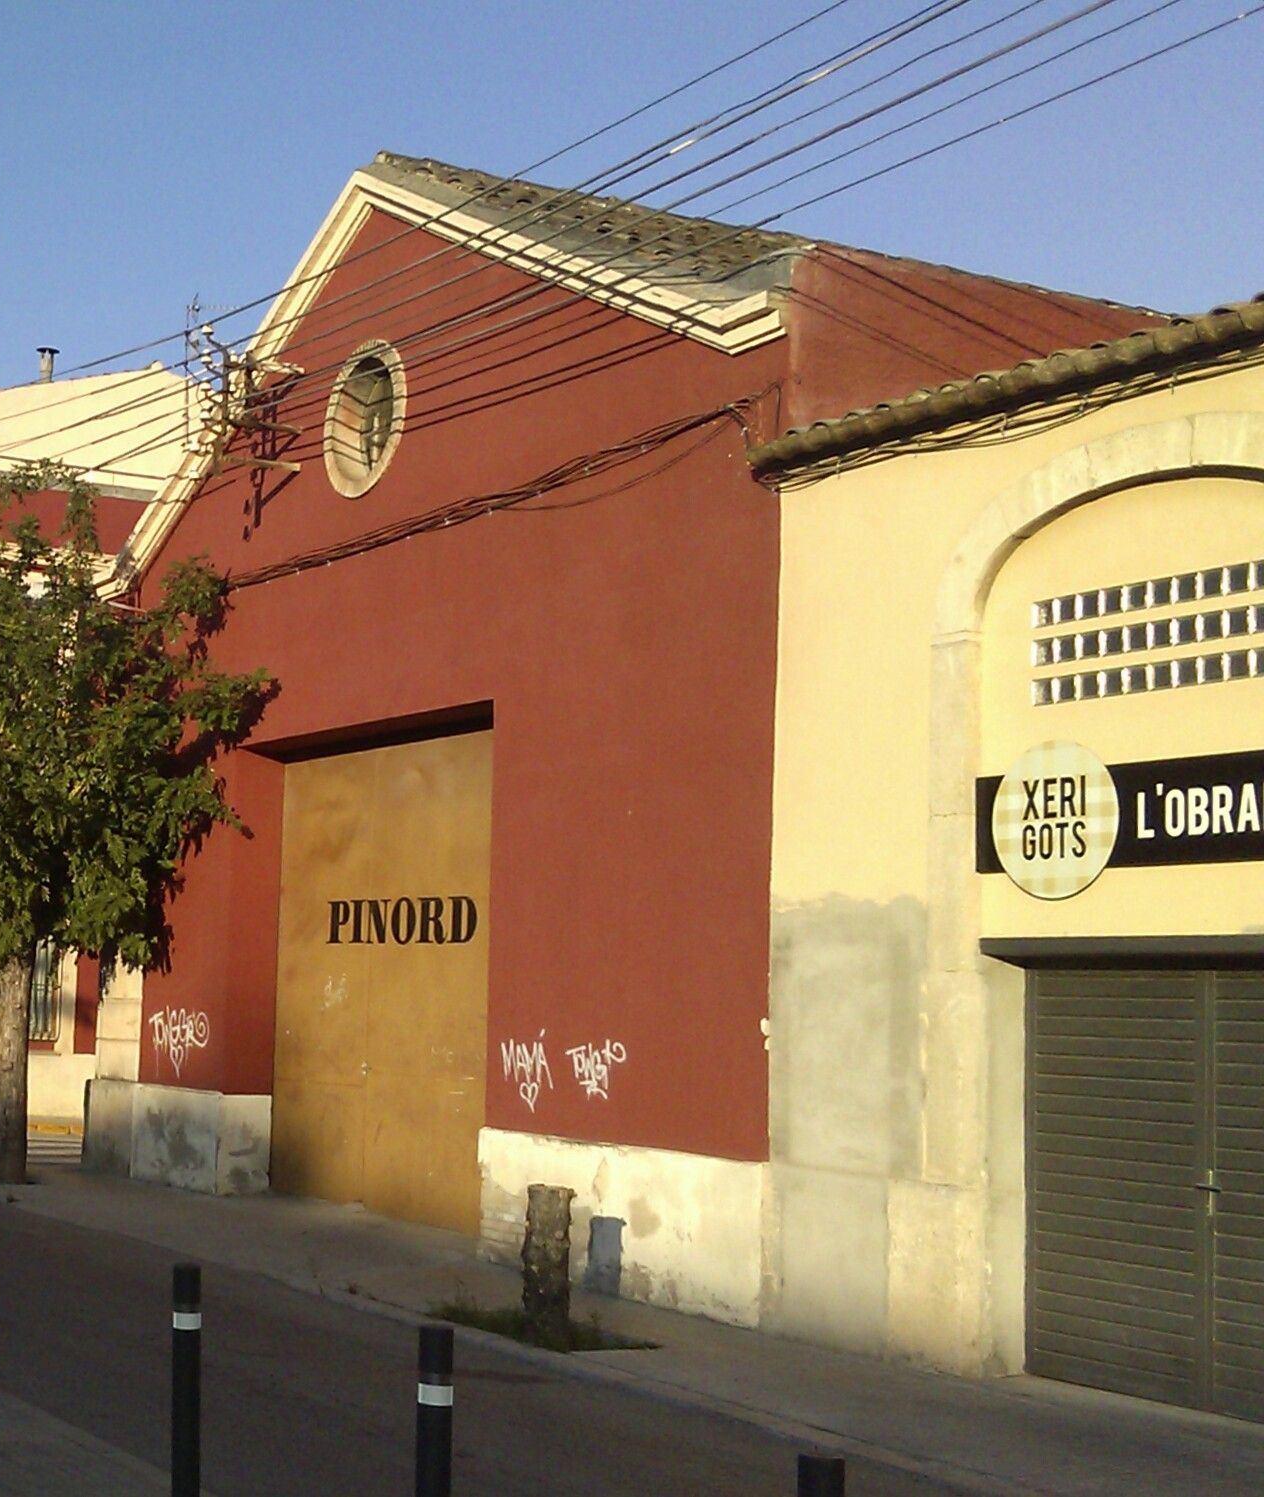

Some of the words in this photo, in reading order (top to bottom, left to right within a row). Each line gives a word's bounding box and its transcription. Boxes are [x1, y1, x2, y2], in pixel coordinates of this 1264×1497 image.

[1022, 775, 1086, 821] XERI
[1136, 782, 1264, 839] L'OBRA
[1022, 821, 1087, 861] GOTS
[326, 895, 478, 945] PINORD
